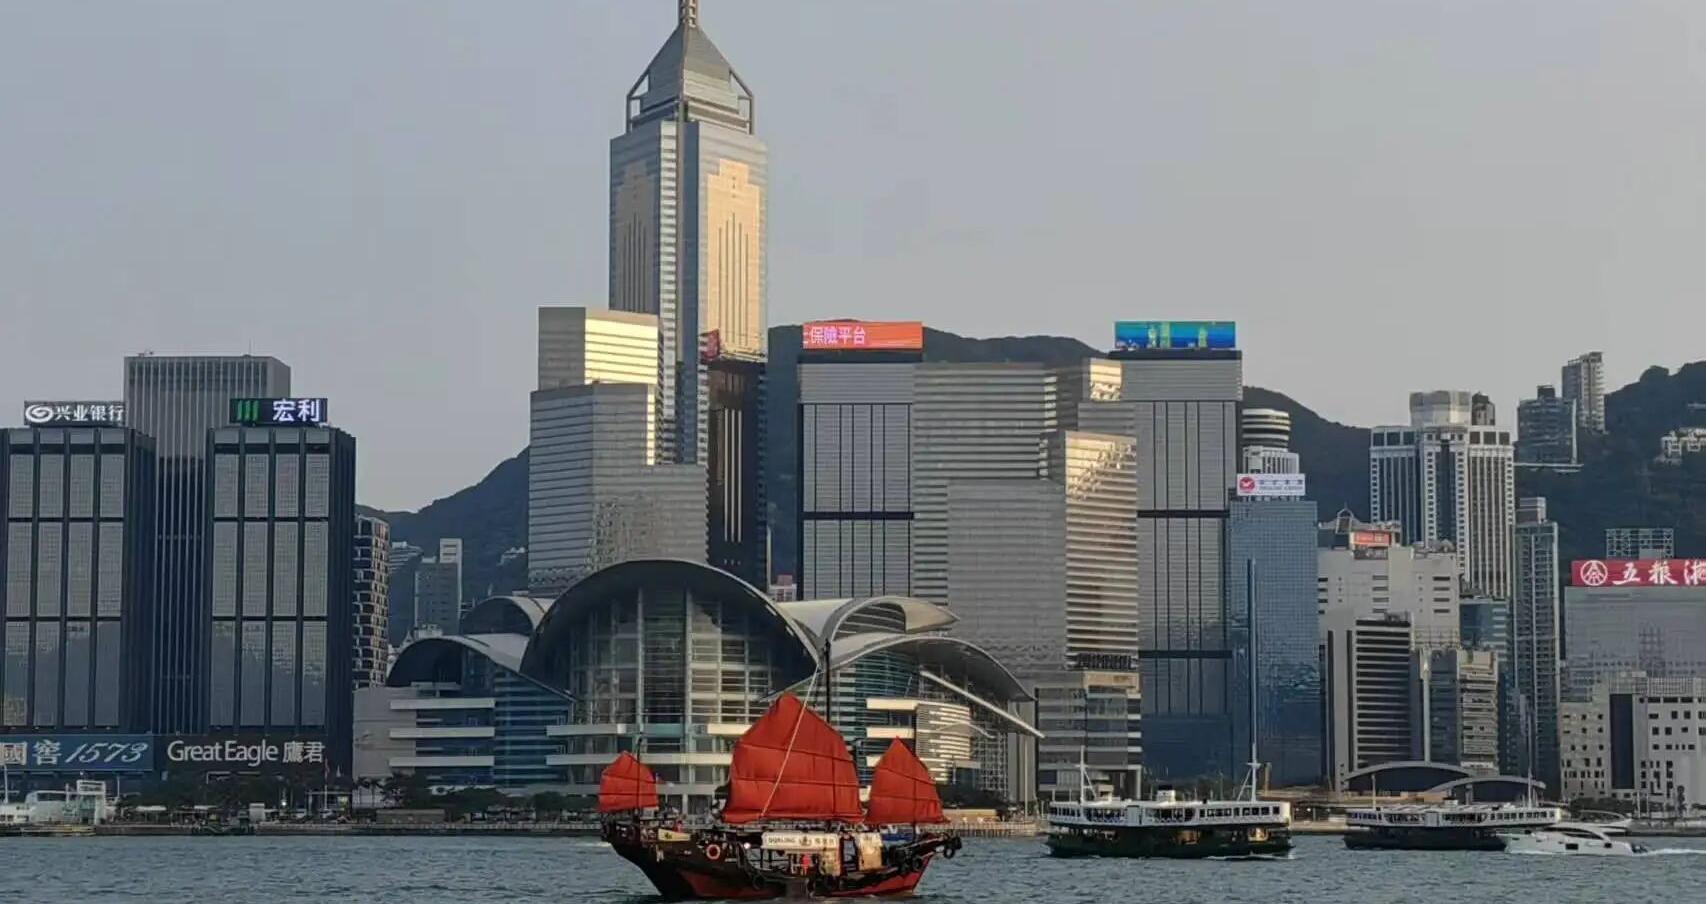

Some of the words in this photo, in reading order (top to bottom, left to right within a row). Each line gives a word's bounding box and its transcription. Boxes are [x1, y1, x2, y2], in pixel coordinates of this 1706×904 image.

[53, 403, 125, 423] 兴业银行
[273, 399, 320, 422] 宏利
[65, 742, 148, 763] 1573
[167, 740, 223, 762] Great
[225, 740, 279, 766] Eagle
[282, 741, 326, 764] 鷹君
